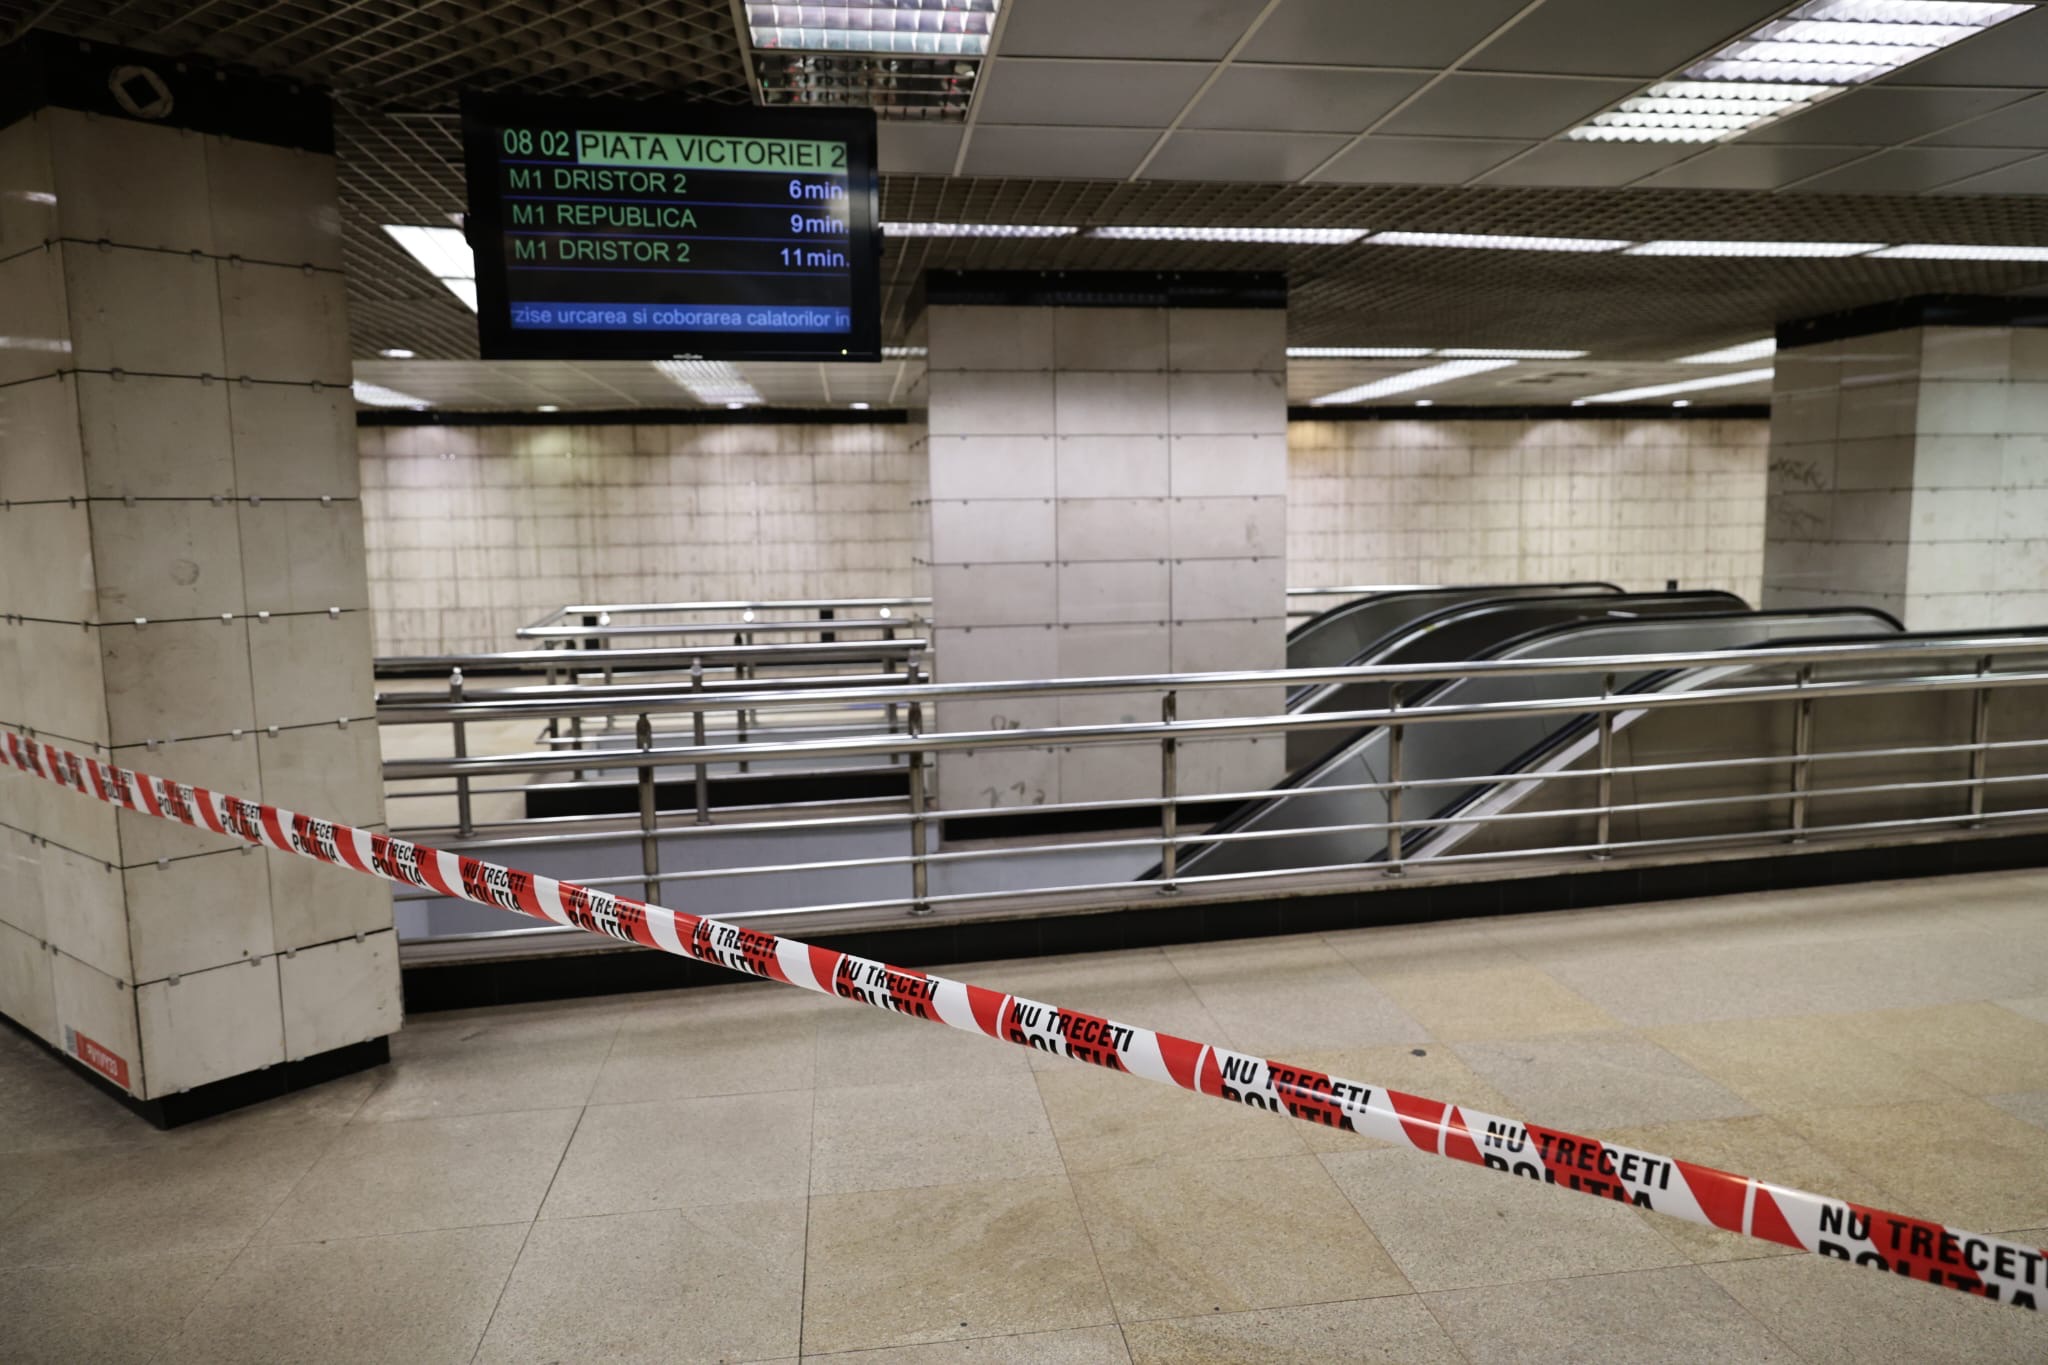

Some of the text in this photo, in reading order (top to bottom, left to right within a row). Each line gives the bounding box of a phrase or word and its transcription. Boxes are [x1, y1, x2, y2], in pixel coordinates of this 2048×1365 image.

[503, 129, 846, 168] 08 02 PIATA VICTORIEI 2
[509, 168, 542, 190] M1
[554, 169, 667, 193] DRISTOR
[673, 173, 687, 194] 2
[789, 179, 802, 199] 6
[512, 204, 849, 234] M1 REPUBLICA 9 min.
[514, 239, 850, 268] M1 DRISTOR 2 11 min.
[512, 306, 552, 324] zise
[557, 310, 627, 325] urcarea
[633, 307, 648, 325] si
[653, 308, 742, 326] coborarea
[747, 309, 832, 327] calatorilor
[388, 841, 427, 866] TRECETI
[371, 855, 427, 886] POLITIA
[463, 861, 528, 893] NU TRECETI
[463, 880, 526, 912] POLITIA
[692, 920, 779, 959] NU TRECETI
[837, 958, 940, 1003] NU TRECETI
[1011, 1003, 1042, 1029] NU
[1046, 1010, 1135, 1053] TRECETI
[1221, 1055, 1259, 1085] NU
[1266, 1065, 1372, 1114] TRECETI
[1484, 1120, 1528, 1153] NU
[1538, 1132, 1672, 1191] TRECETI
[1818, 1203, 1872, 1241] NU
[1887, 1219, 2048, 1289] TRECET
